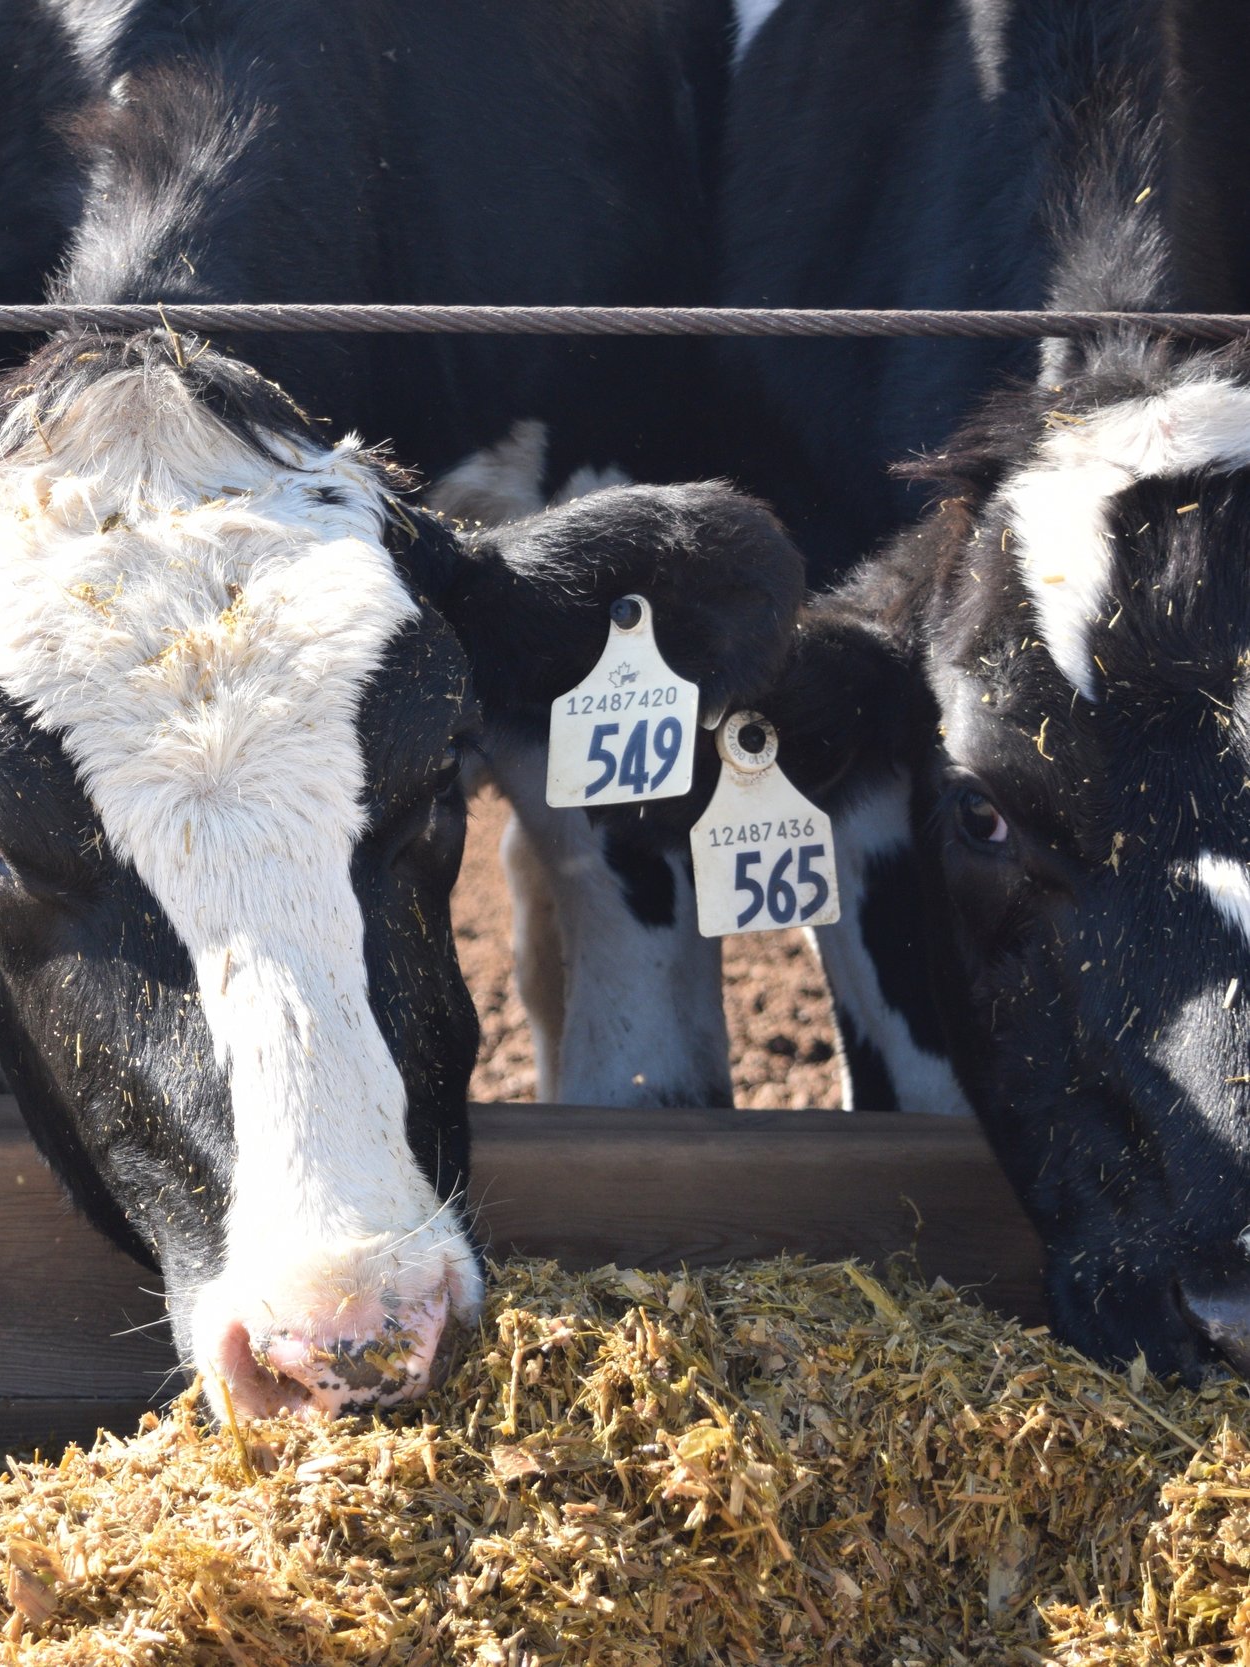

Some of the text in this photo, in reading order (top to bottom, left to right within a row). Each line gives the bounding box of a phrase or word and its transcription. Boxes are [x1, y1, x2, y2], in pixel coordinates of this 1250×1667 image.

[565, 686, 678, 715] 12487420
[585, 716, 682, 799] 549
[708, 817, 815, 847] 12487436
[735, 844, 829, 929] 565
